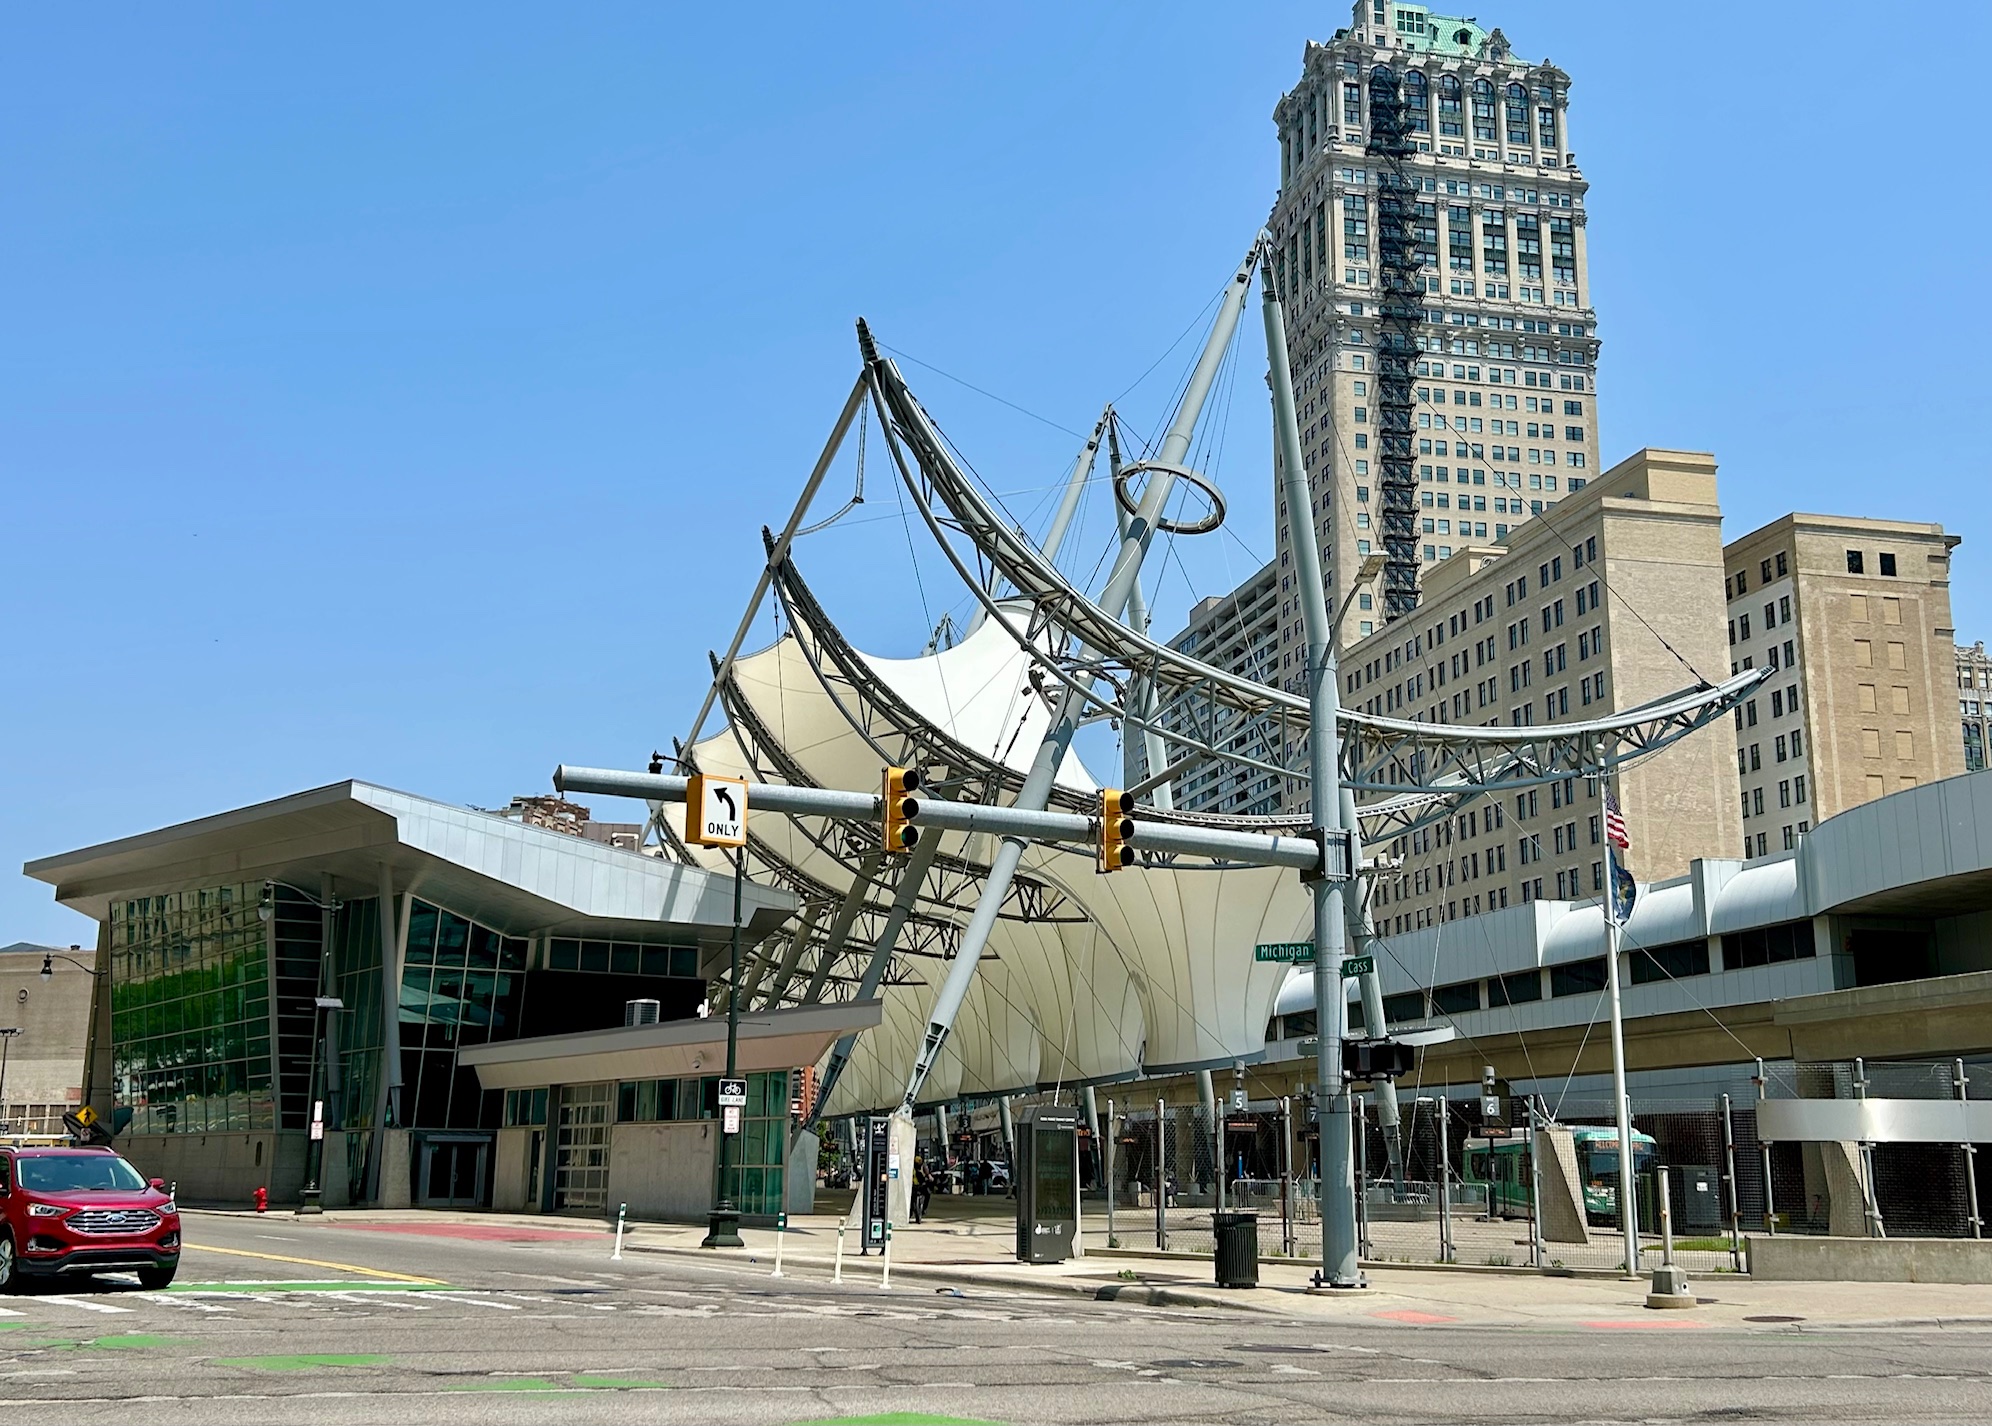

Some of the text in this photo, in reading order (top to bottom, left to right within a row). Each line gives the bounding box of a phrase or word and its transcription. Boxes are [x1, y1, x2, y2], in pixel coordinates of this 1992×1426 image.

[708, 822, 739, 837] ONLY
[1261, 945, 1309, 960] Michigan
[1348, 961, 1368, 974] Cass
[1235, 1097, 1243, 1109] 5
[1486, 1103, 1495, 1115] 6
[1310, 1111, 1317, 1122] 7
[963, 1119, 968, 1128] 3
